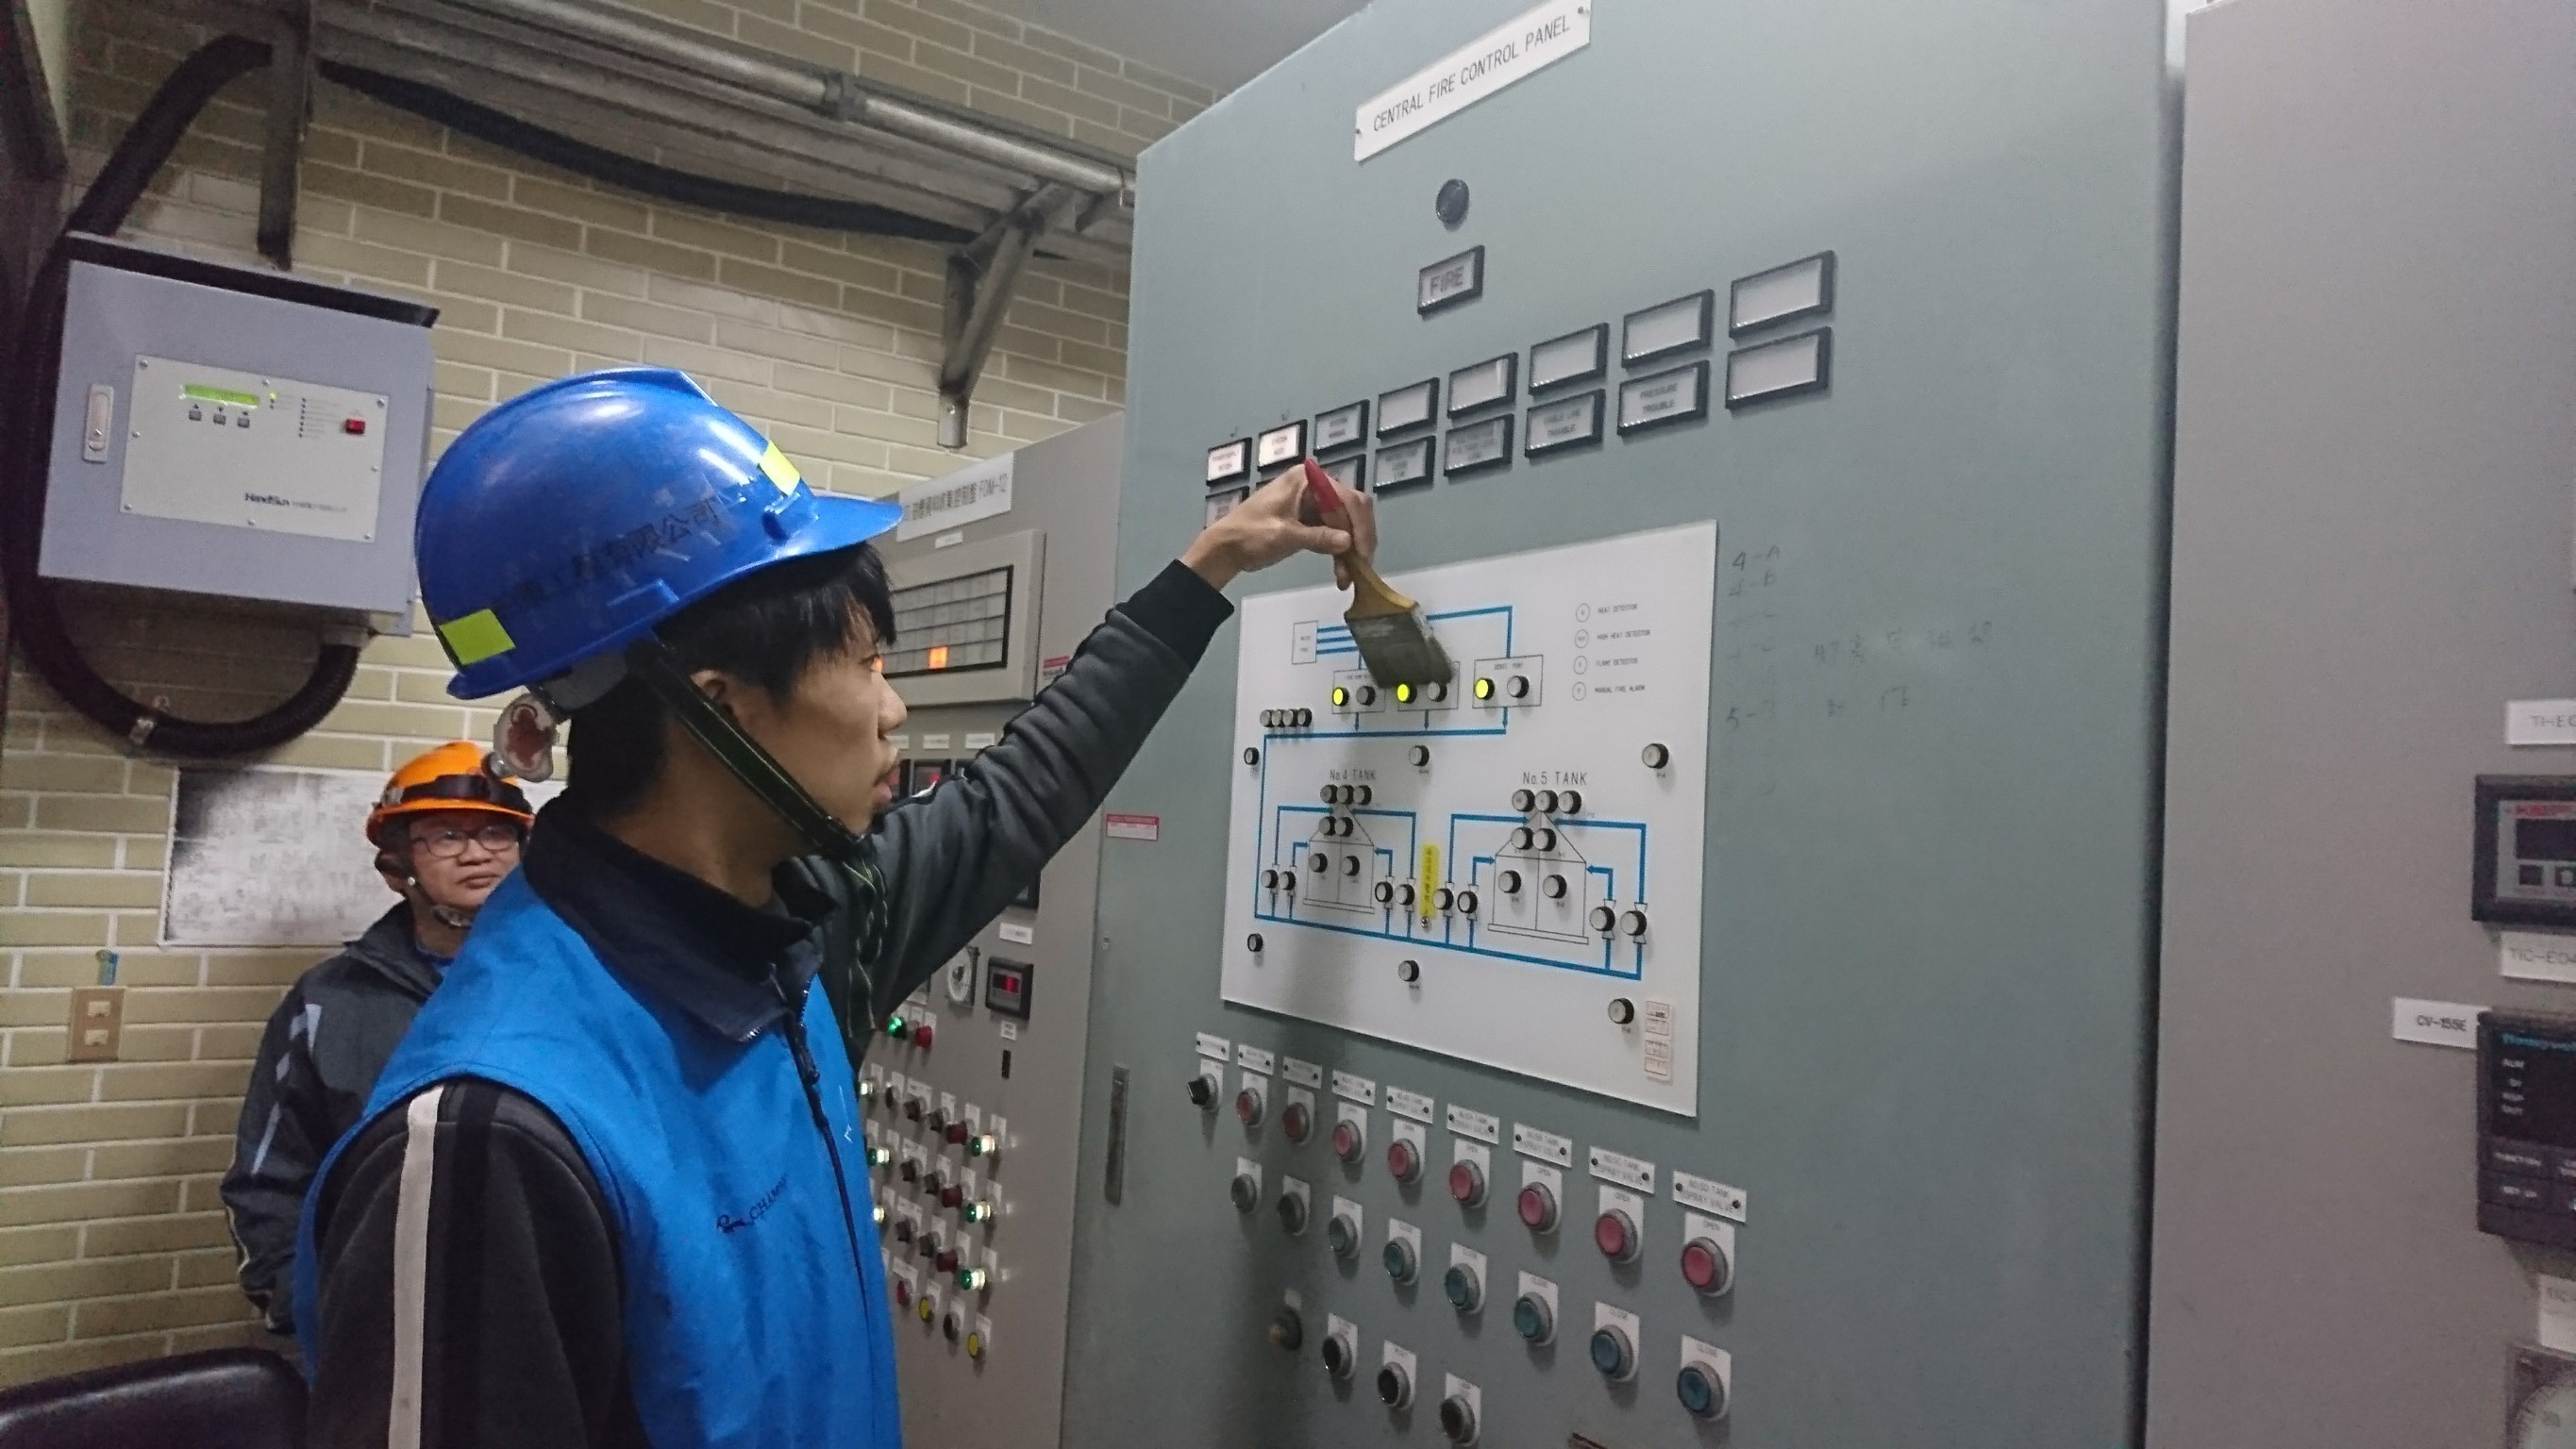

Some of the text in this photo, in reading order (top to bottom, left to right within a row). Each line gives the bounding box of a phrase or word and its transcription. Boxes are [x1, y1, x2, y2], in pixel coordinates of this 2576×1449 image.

[1373, 15, 1570, 132] CENTRAL FIRE CONTROL PANEL
[1430, 266, 1464, 296] FIRE
[1643, 399, 1675, 413] TROUBLE
[1352, 769, 1376, 781] TANK
[1555, 772, 1588, 786] TANK
